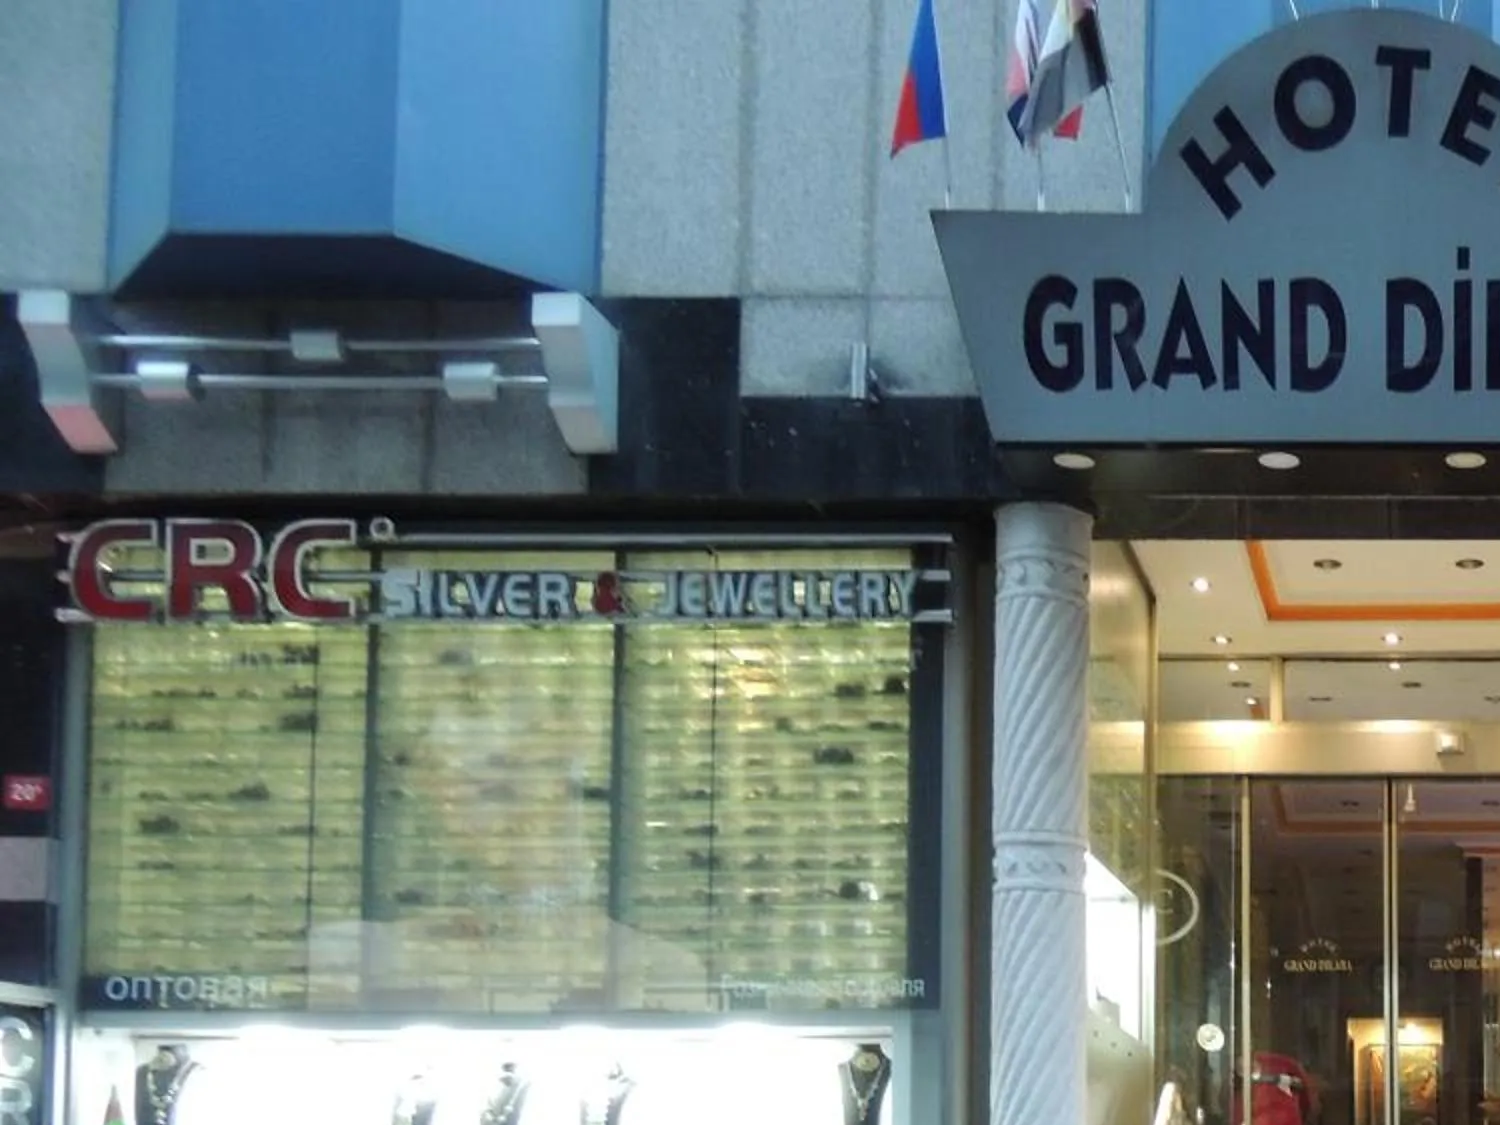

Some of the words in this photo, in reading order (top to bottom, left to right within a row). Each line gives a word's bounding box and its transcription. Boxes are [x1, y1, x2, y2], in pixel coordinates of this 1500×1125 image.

[1022, 273, 1348, 394] GRAND
[68, 517, 357, 624] CRC
[381, 570, 571, 617] SILVER
[592, 572, 622, 614] &
[659, 570, 918, 617] JEWELLERY
